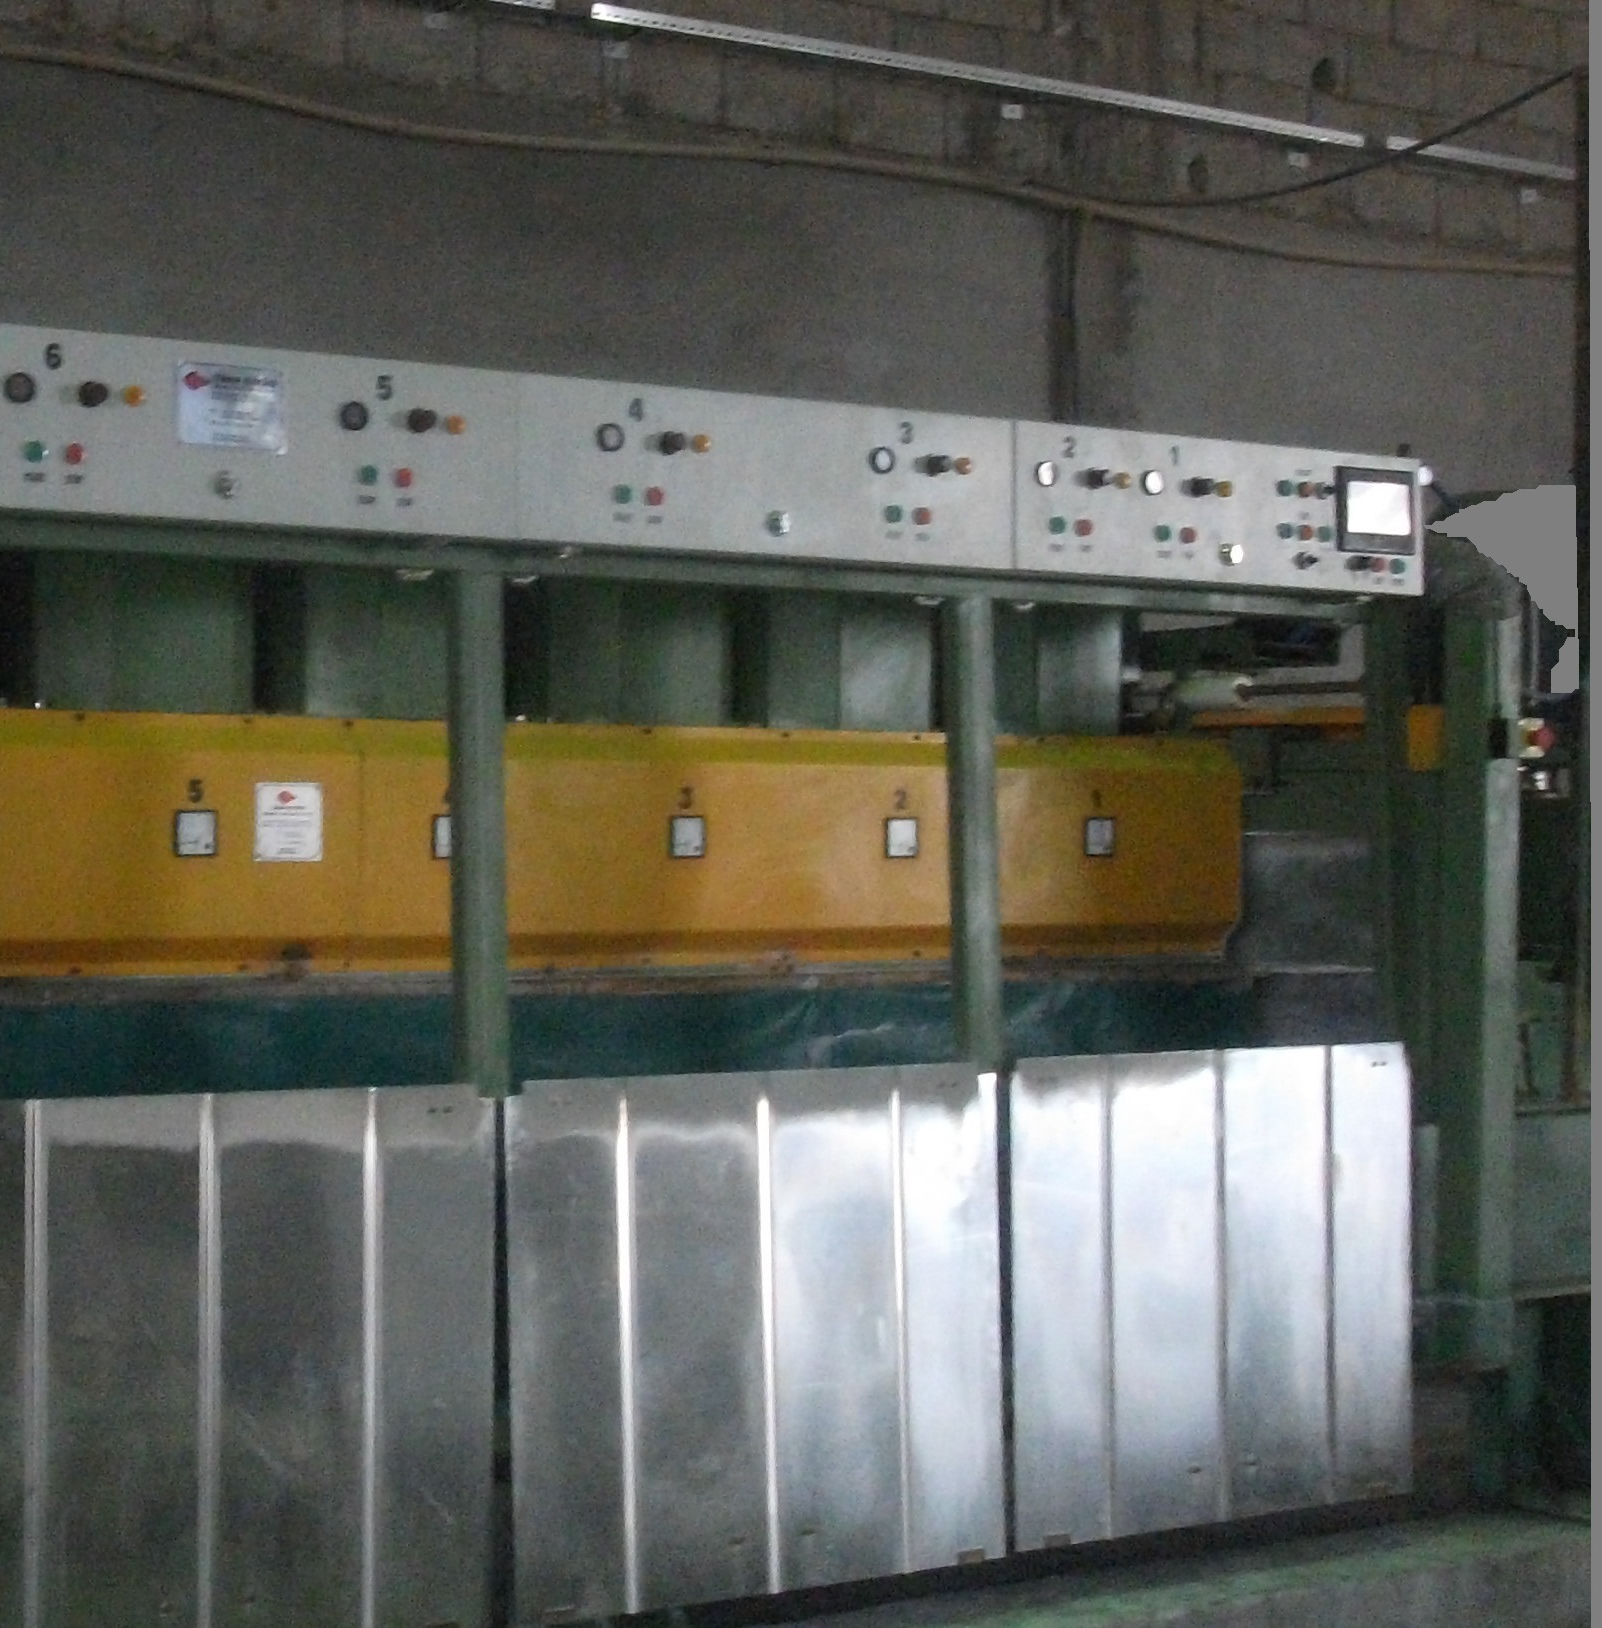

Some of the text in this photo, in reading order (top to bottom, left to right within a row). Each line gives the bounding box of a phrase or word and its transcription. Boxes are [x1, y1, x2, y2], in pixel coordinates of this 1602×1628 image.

[45, 343, 62, 370] 6
[376, 375, 394, 400] 5
[628, 398, 644, 422] 4
[1062, 436, 1077, 459] 2
[1169, 445, 1180, 466] 1
[188, 779, 203, 803] 5
